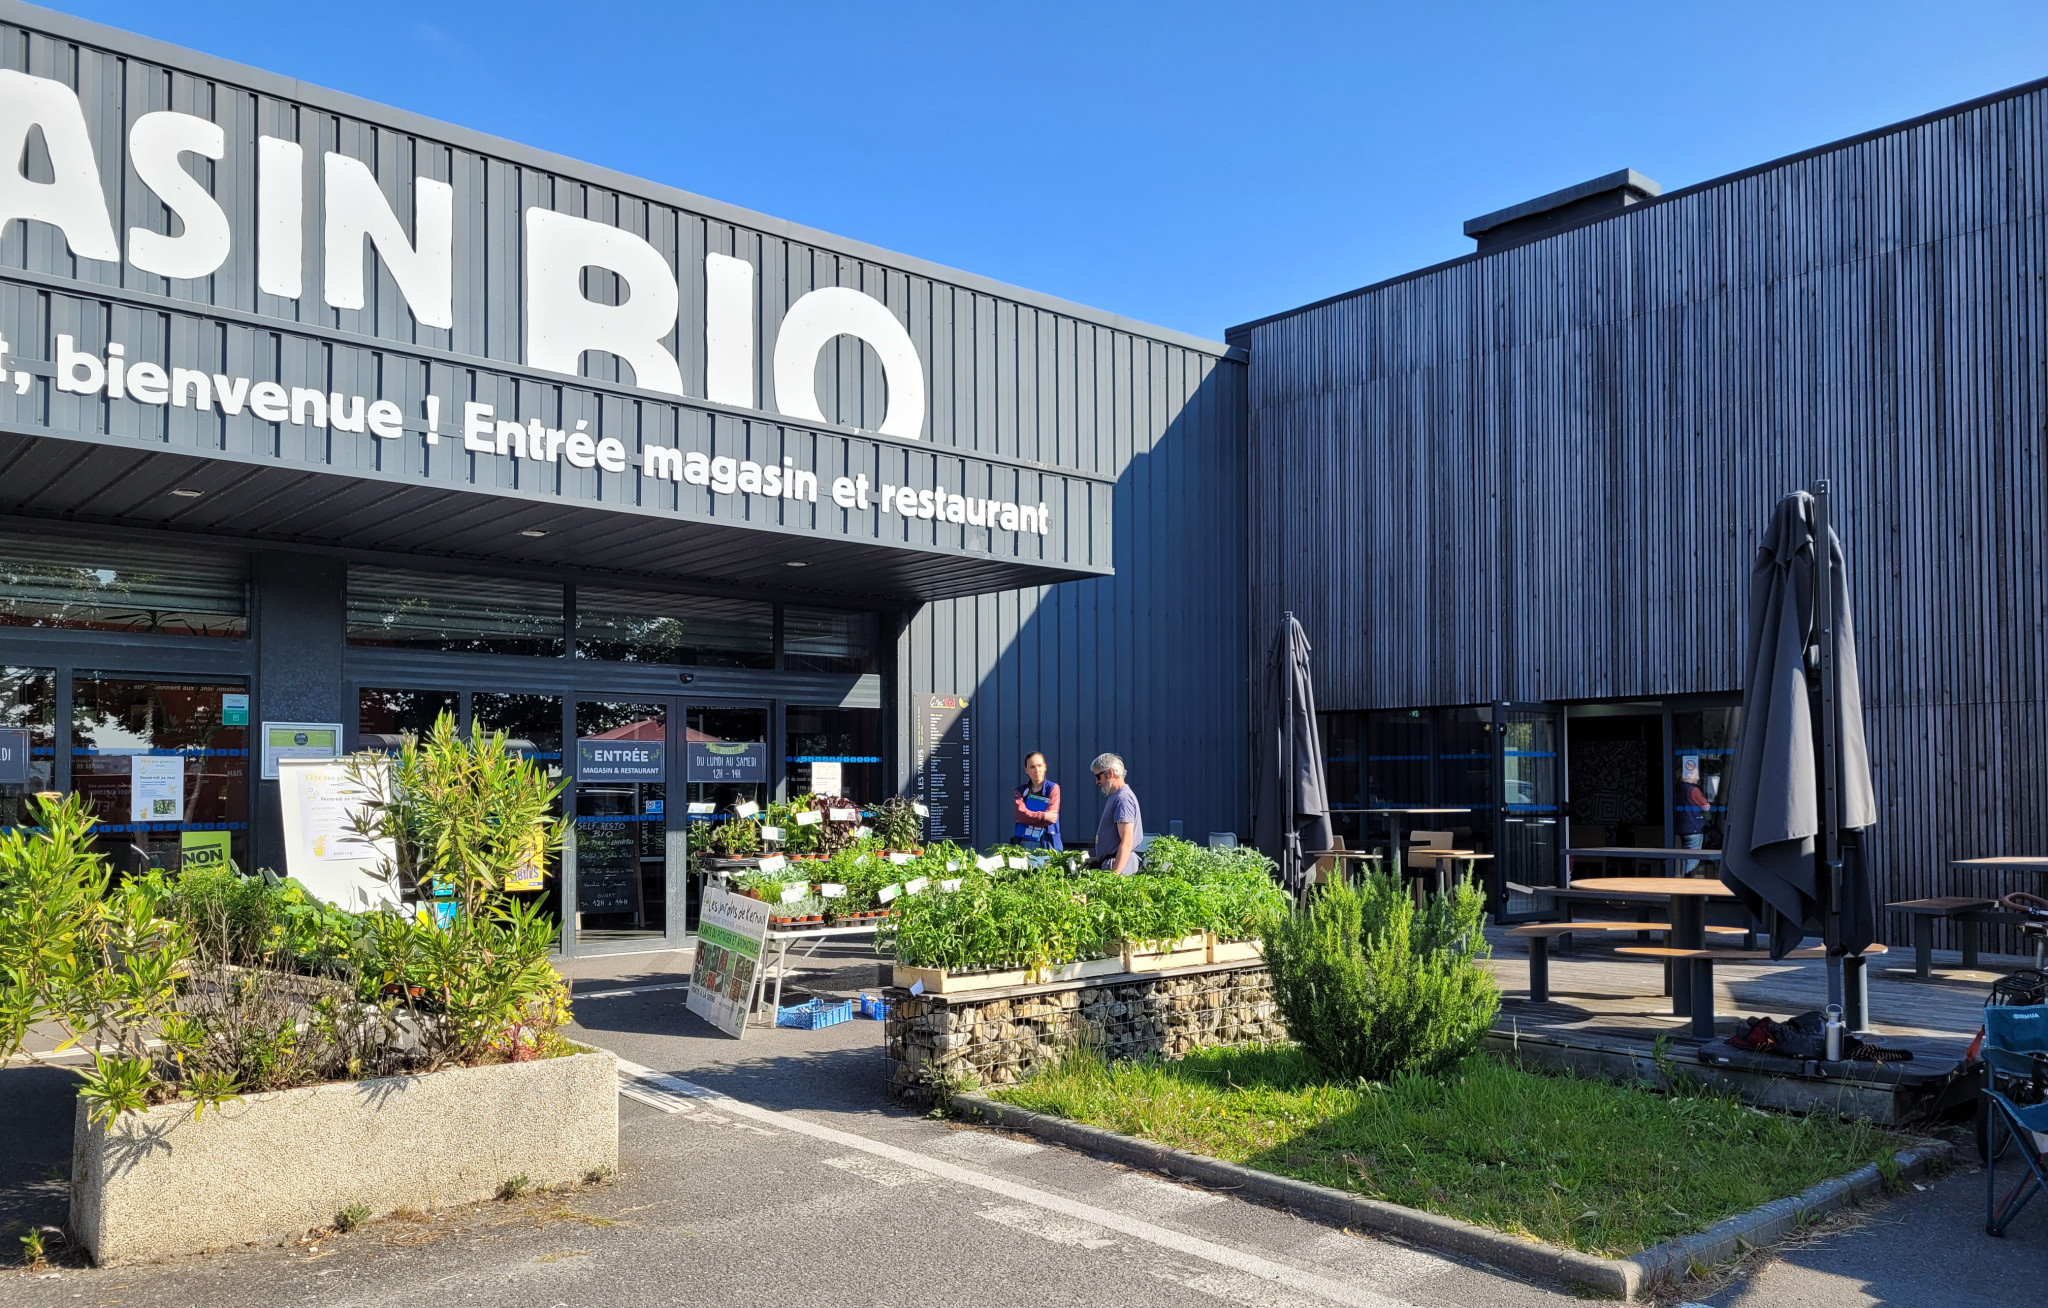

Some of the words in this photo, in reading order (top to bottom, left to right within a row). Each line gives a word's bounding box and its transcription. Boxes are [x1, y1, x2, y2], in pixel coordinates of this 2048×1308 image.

[0, 68, 453, 329] ASIN
[526, 206, 925, 440] BIO
[57, 333, 403, 439] bienvenue
[426, 395, 440, 445] !
[464, 401, 626, 473] Entrée
[644, 443, 817, 503] magasin
[832, 473, 869, 510] et
[881, 482, 1049, 536] restaurant
[594, 748, 649, 762] ENTRÉE
[697, 756, 705, 767] DU
[707, 756, 724, 767] LUNDI
[726, 756, 733, 767] AU
[736, 757, 757, 767] SAMEDI
[713, 769, 723, 779] 12H
[182, 848, 223, 866] NON
